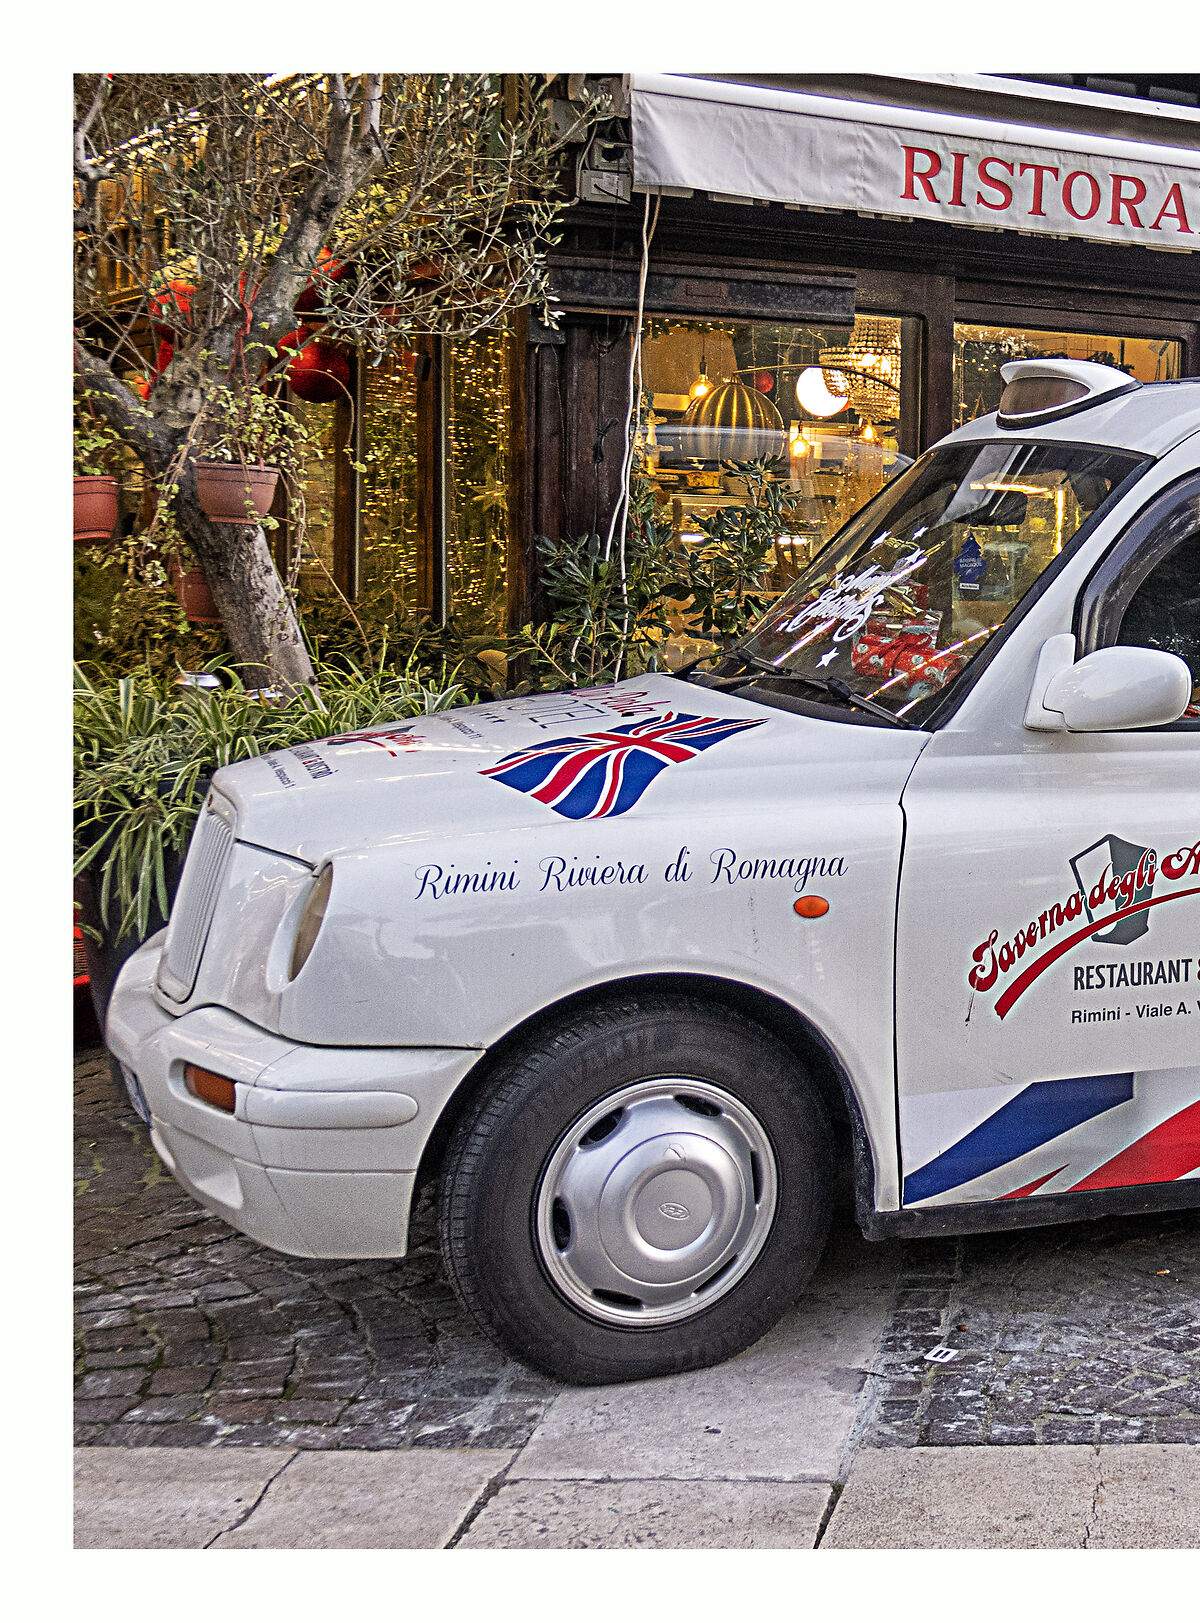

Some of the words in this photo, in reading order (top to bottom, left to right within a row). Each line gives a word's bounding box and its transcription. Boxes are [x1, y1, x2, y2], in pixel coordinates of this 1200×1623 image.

[415, 860, 520, 899] Rimini
[540, 856, 648, 891] Riviera
[665, 846, 693, 882] di
[710, 848, 848, 892] Romagna
[968, 890, 1085, 992] Taverna
[1089, 852, 1157, 911] degli
[1074, 959, 1192, 990] RESTAURANT
[1072, 1007, 1120, 1023] Rimini
[1136, 1004, 1172, 1018] Viale
[1177, 1002, 1191, 1015] A.
